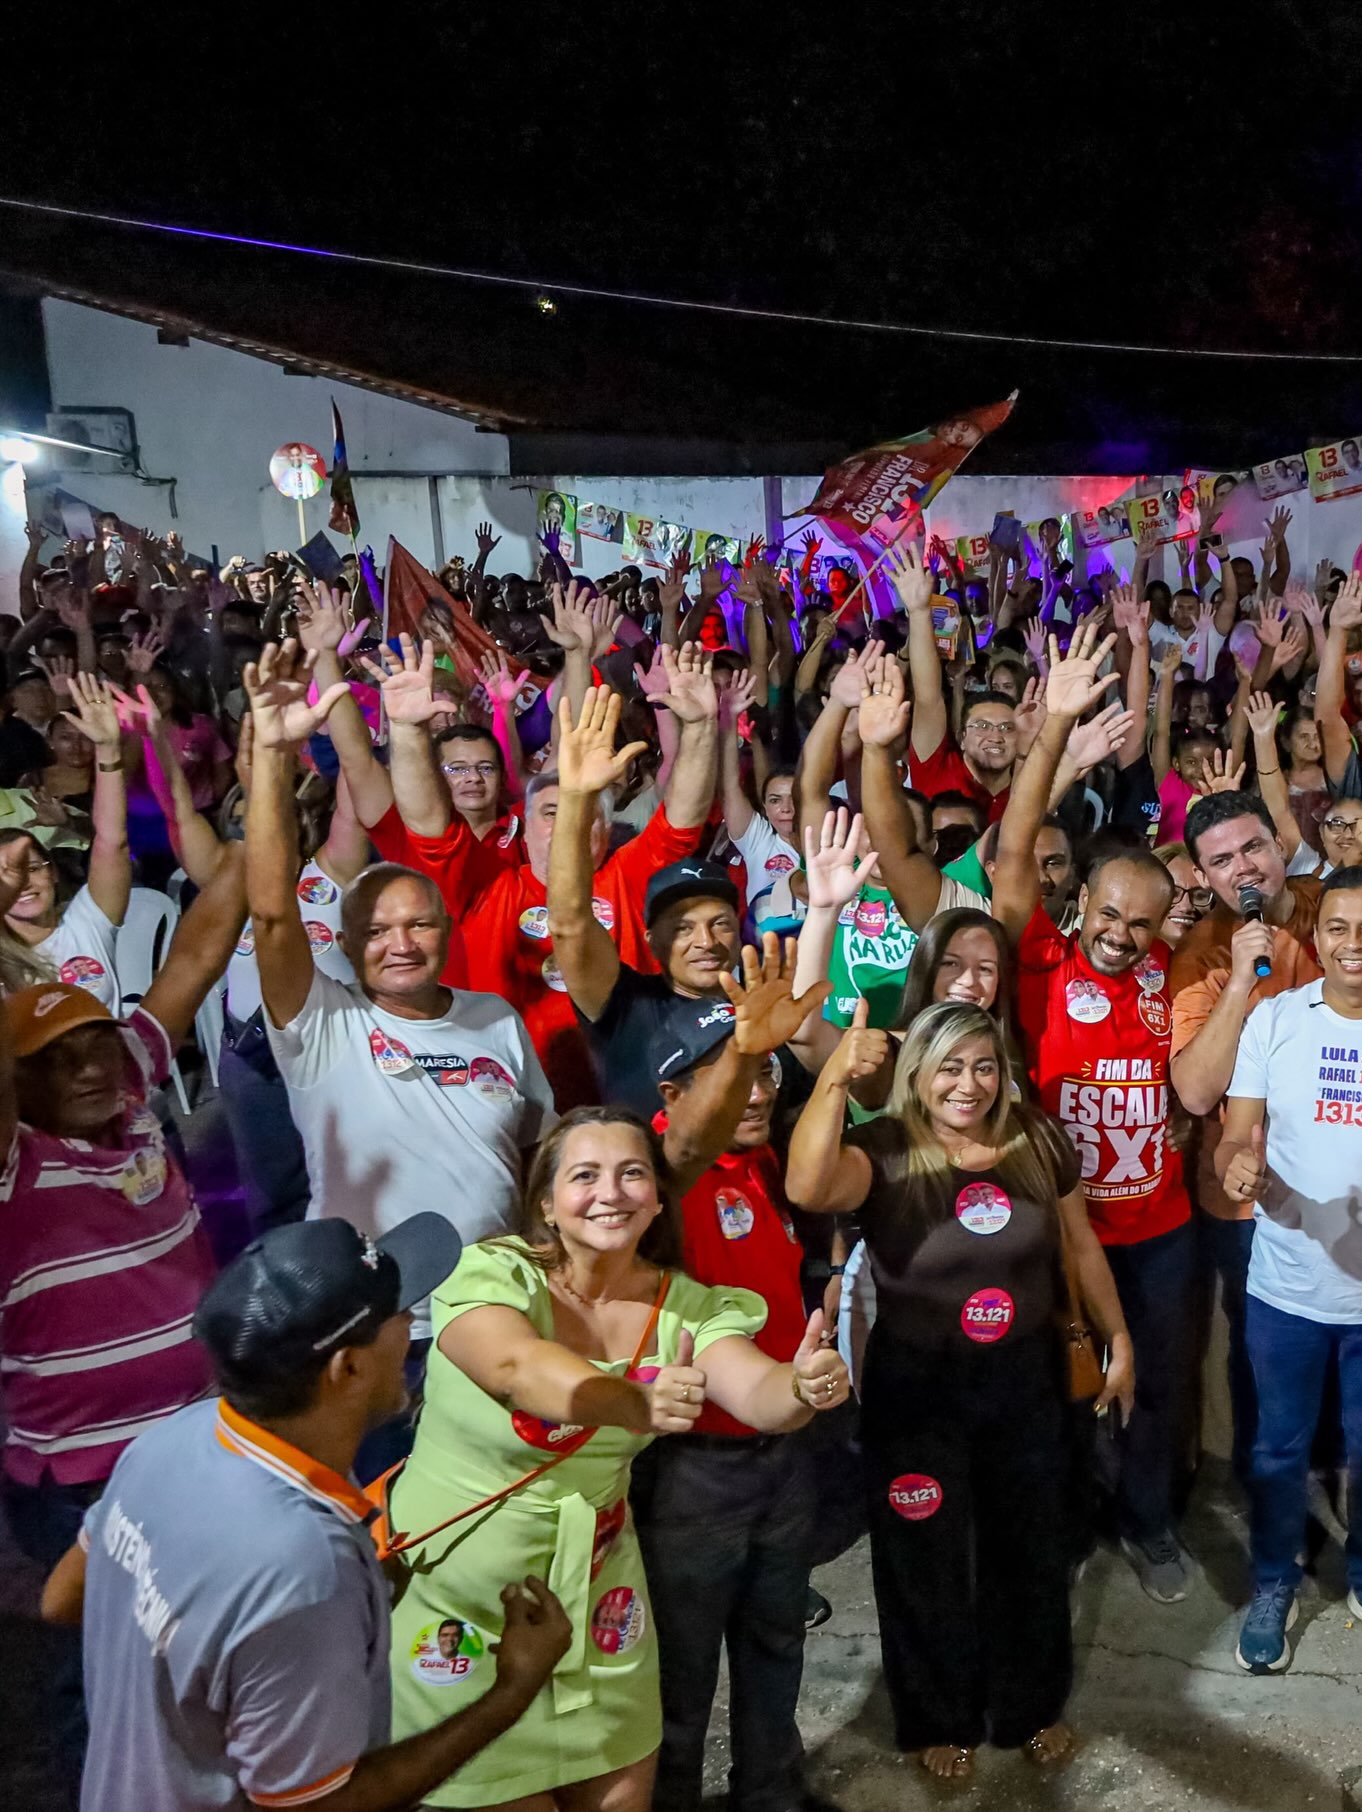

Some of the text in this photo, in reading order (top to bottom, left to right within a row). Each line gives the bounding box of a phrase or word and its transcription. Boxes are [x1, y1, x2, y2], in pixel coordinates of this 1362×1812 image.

[1319, 448, 1338, 468] 13
[1315, 469, 1348, 482] RAFAEL
[852, 454, 913, 525] FRANCISCO
[1140, 499, 1159, 517] 13
[638, 519, 654, 537] 13
[1137, 518, 1169, 533] RAFAEL
[969, 537, 987, 556] 13
[850, 936, 881, 962] NA
[1145, 999, 1164, 1011] FIM
[1147, 1014, 1166, 1026] 6X1
[416, 1057, 466, 1068] MARESIA
[1321, 1046, 1359, 1063] LULA
[1095, 1059, 1152, 1080] FIM DA
[1318, 1066, 1356, 1083] RAFAEL
[966, 1307, 1011, 1323] 13.121
[891, 1487, 938, 1504] 13.121
[450, 1657, 470, 1674] 13
